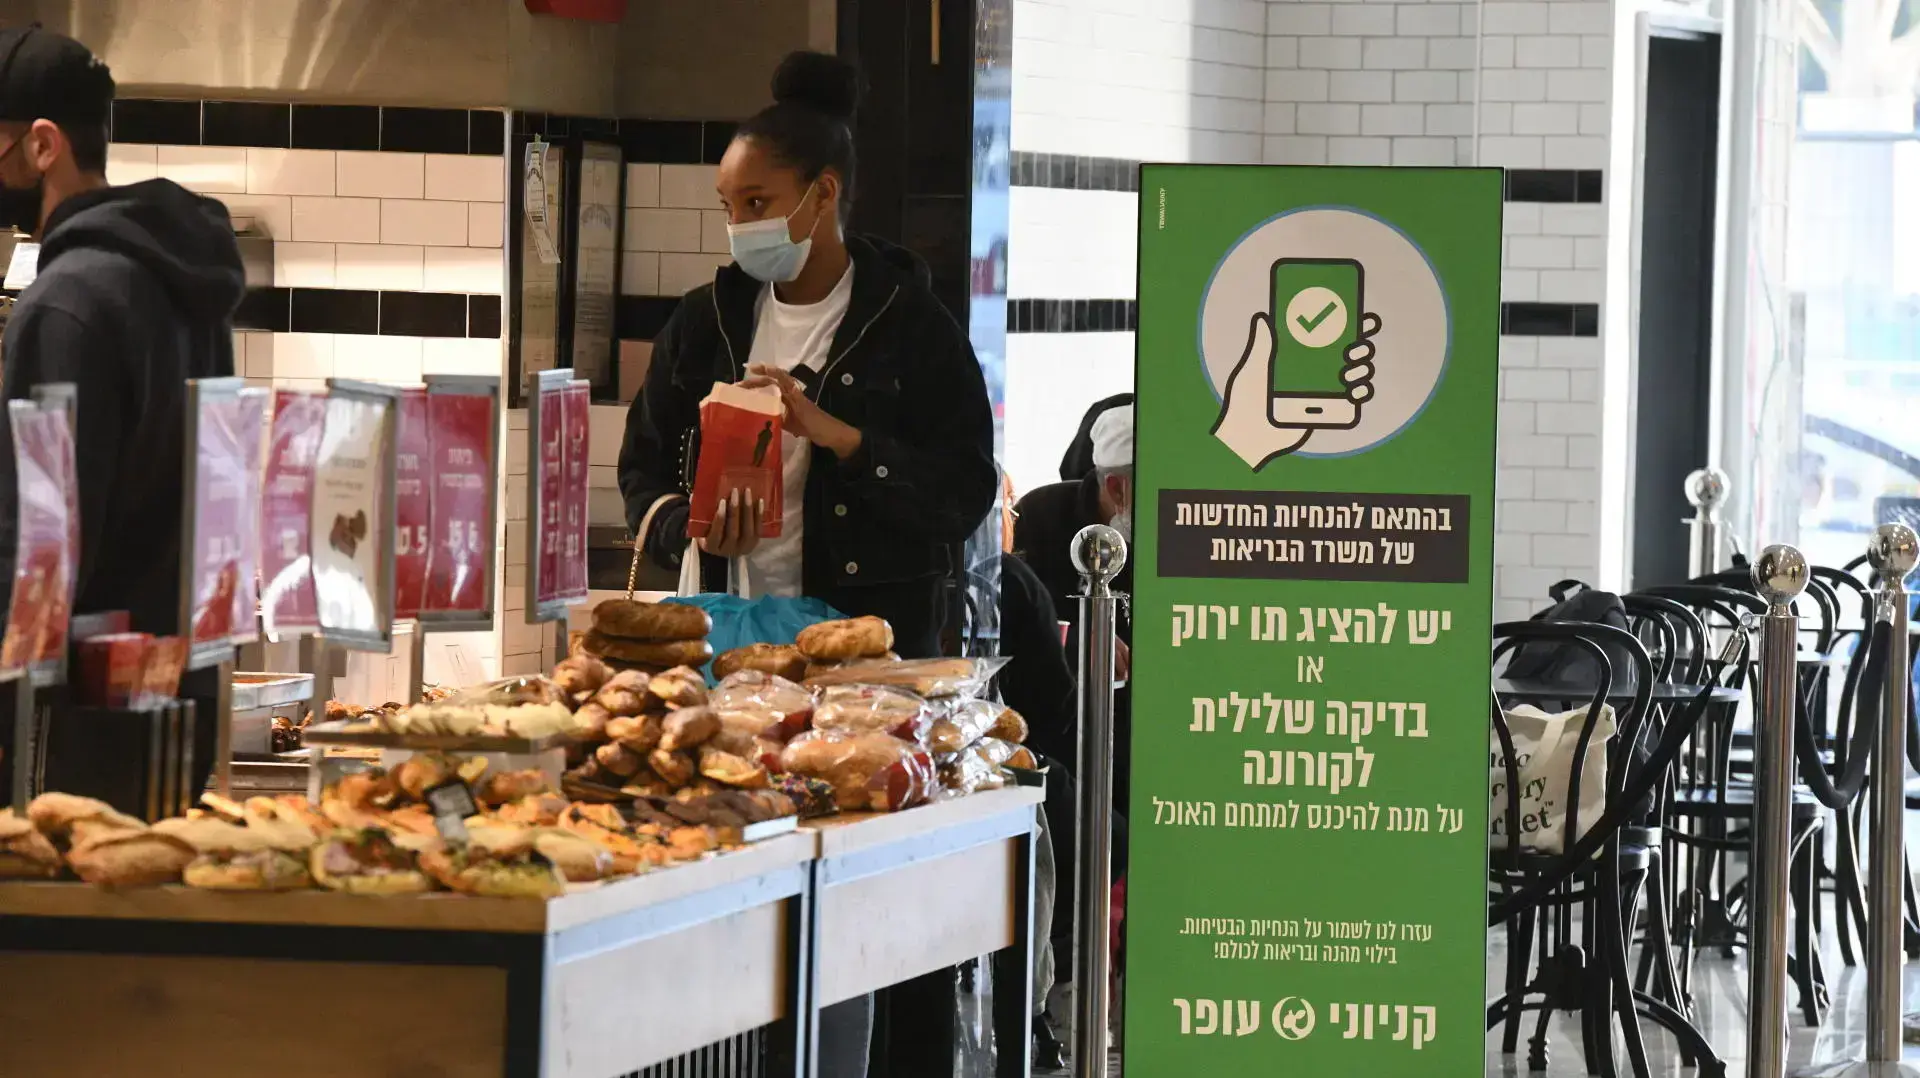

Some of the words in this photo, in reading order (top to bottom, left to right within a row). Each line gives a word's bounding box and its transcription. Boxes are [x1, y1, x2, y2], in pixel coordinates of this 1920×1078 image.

[1175, 502, 1268, 527] החדשות
[1273, 502, 1365, 529] להנחיות
[1371, 506, 1452, 531] בהתאם
[1210, 537, 1305, 563] הבריאות
[1311, 540, 1374, 564] משרד
[1380, 537, 1415, 565] של
[1171, 604, 1240, 648] ירוק
[1250, 605, 1288, 642] תו
[1295, 602, 1398, 644] להציג
[1407, 609, 1452, 645] יש
[1297, 655, 1324, 684] או
[1189, 691, 1315, 735] שלילית
[1325, 700, 1429, 744] בדיקה
[1243, 745, 1375, 795] לקורונה
[1152, 795, 1216, 827] האוכל
[1224, 799, 1300, 829] למתחם
[1307, 801, 1381, 831] להיכנס
[1386, 806, 1429, 833] מנת
[1436, 803, 1464, 834] על
[1179, 917, 1246, 936] הבטיחות.
[1249, 919, 1299, 938] הנחיות
[1303, 917, 1322, 939] על
[1325, 919, 1372, 940] לשמור
[1376, 920, 1397, 941] לנו
[1401, 923, 1432, 942] עזרו
[1214, 939, 1260, 960] לכולם!
[1262, 943, 1318, 962] ובריאות
[1322, 944, 1361, 963] מהנה
[1365, 943, 1398, 965] בילוי
[1172, 997, 1261, 1037] עופר
[1329, 1002, 1437, 1051] קניוני
